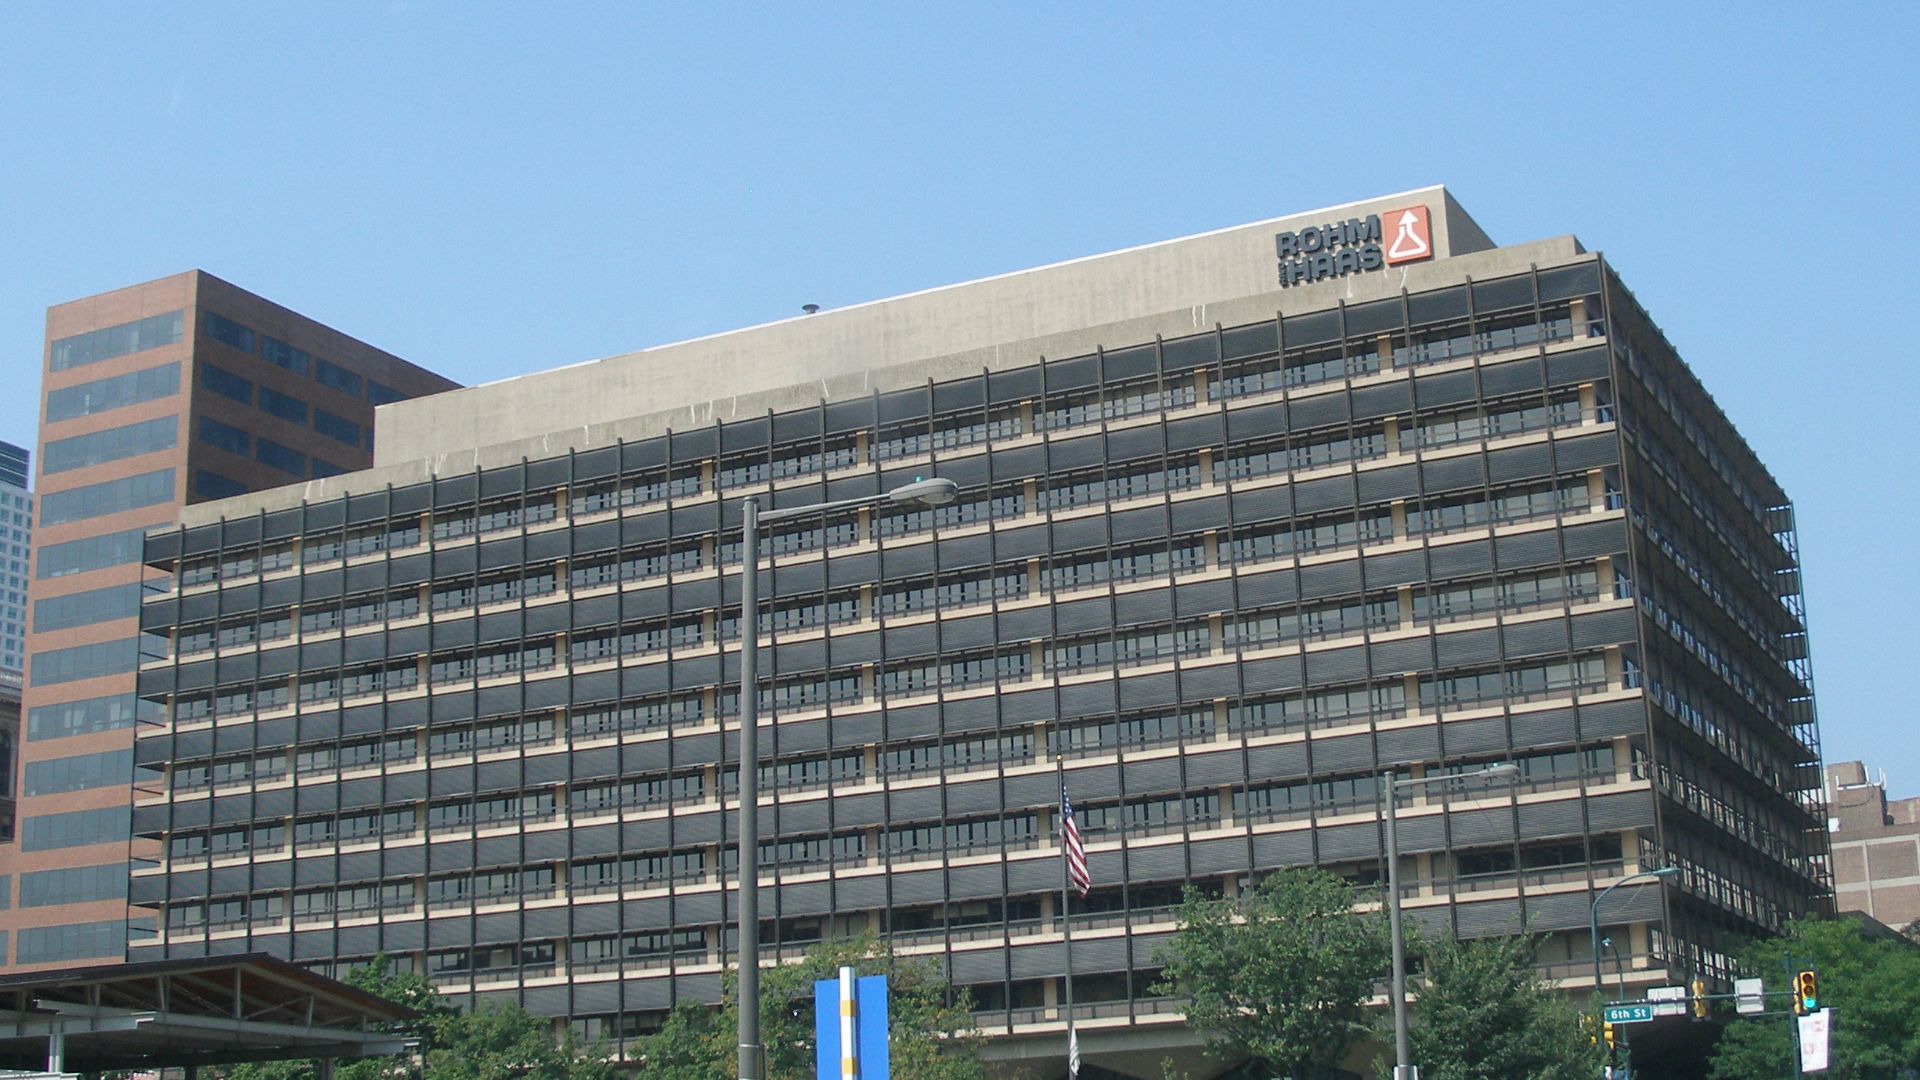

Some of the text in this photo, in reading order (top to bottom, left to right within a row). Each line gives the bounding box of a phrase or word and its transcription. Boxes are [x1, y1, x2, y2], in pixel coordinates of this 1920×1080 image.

[1276, 214, 1382, 258] ROHM
[1287, 242, 1383, 284] HAAS
[1611, 1008, 1646, 1019] 6th St
